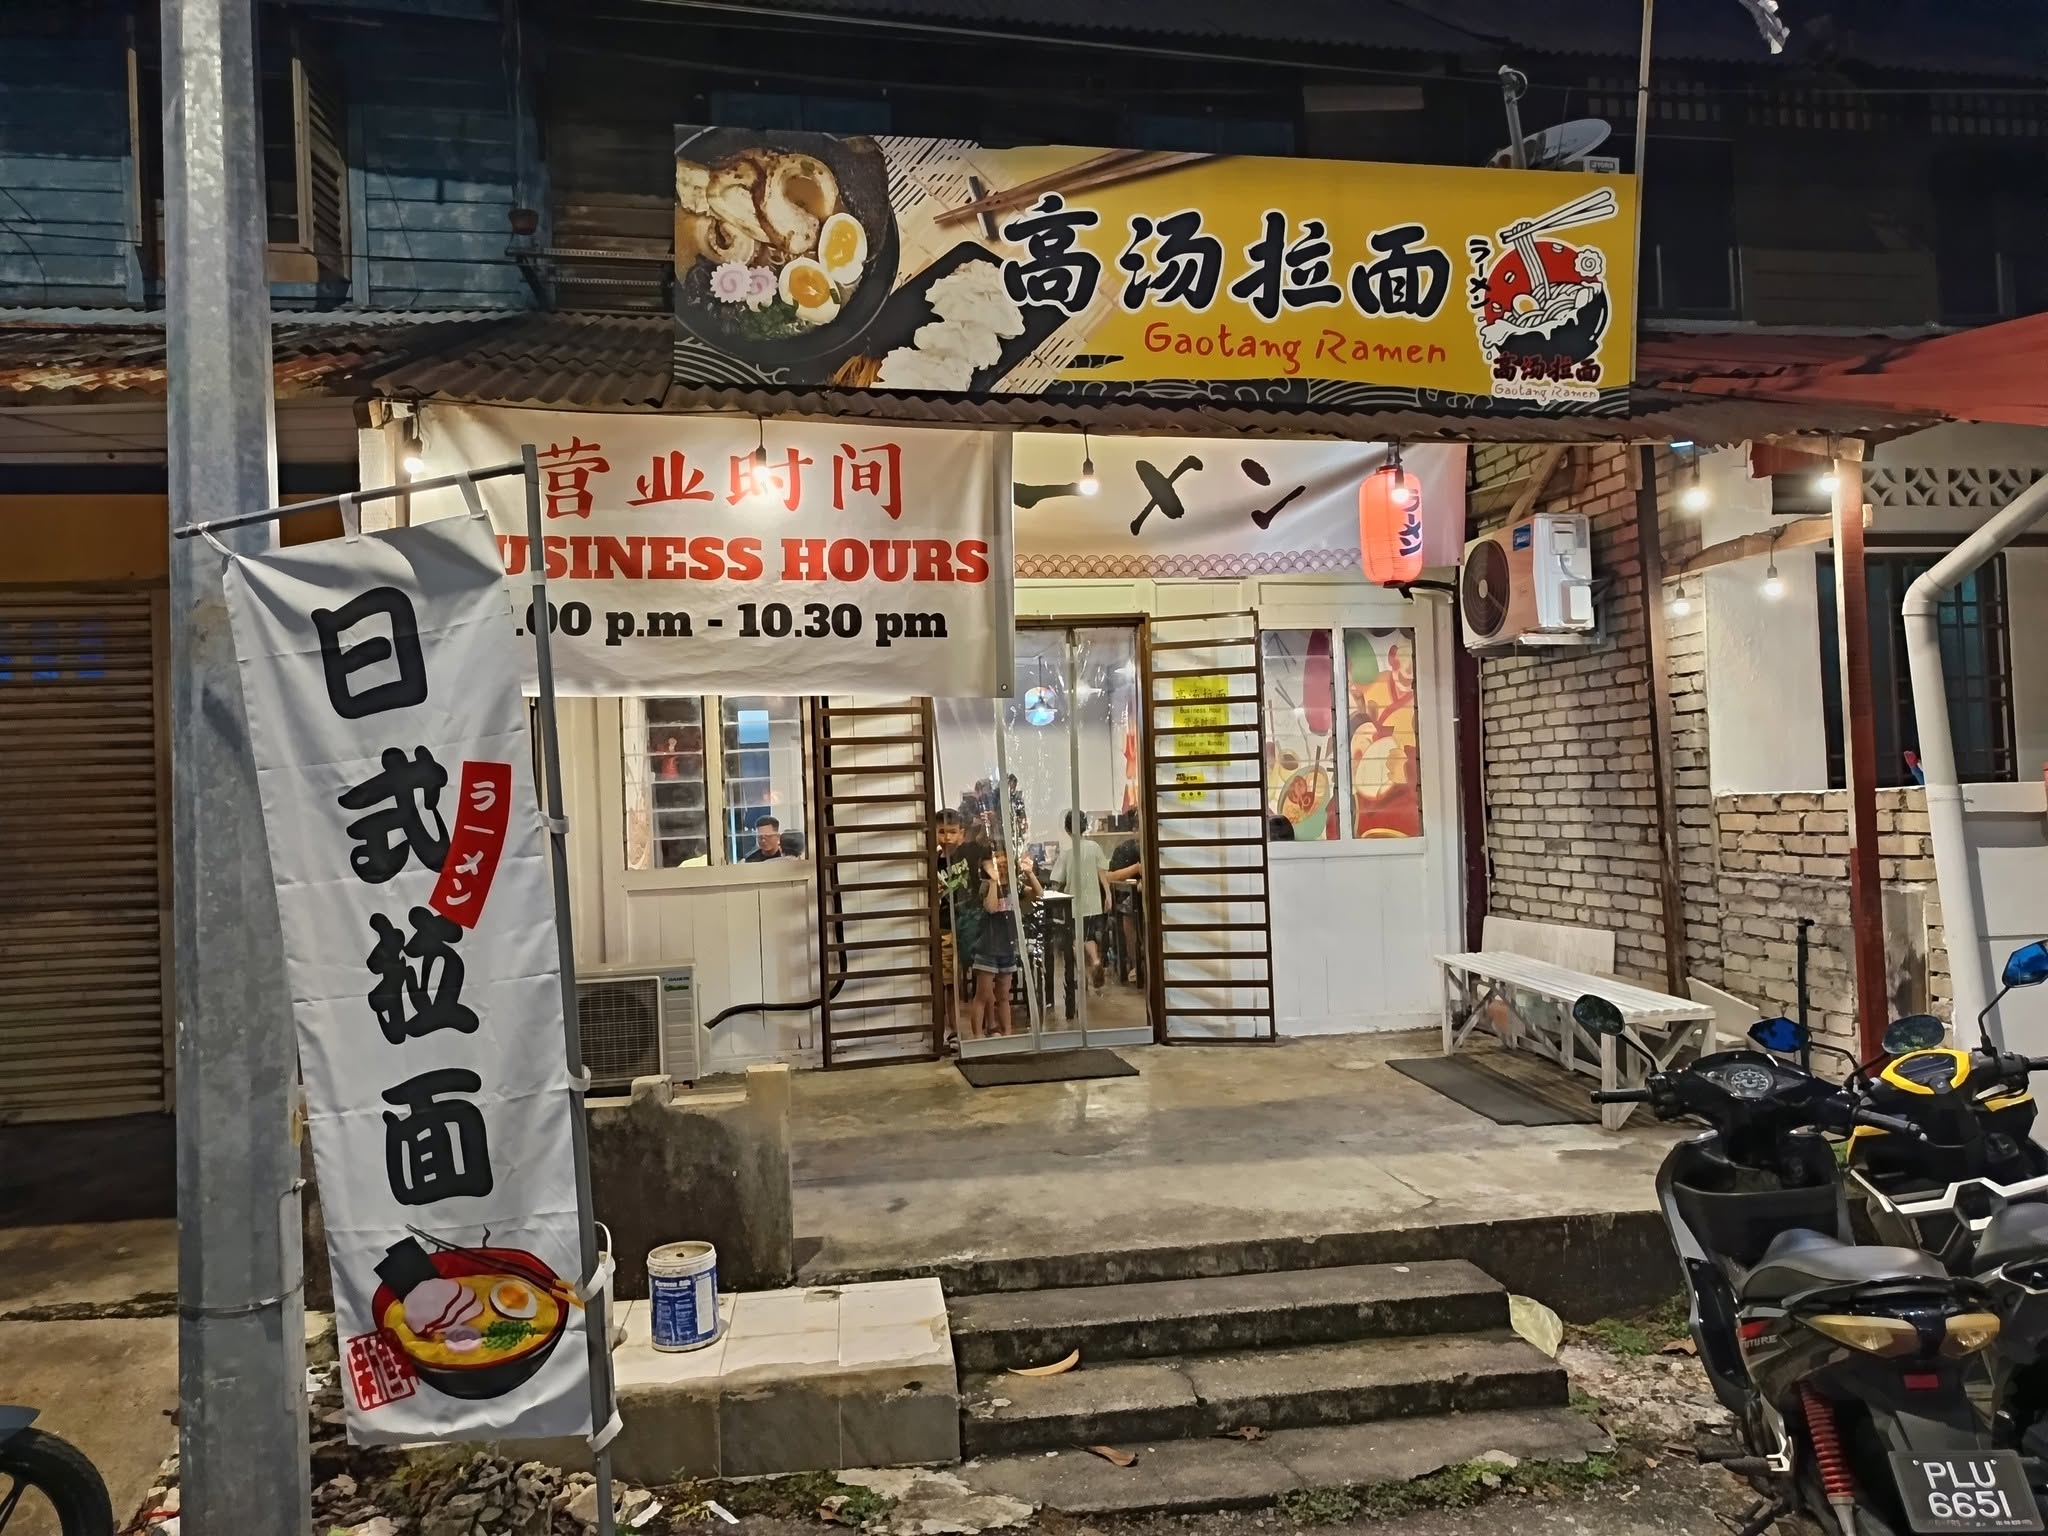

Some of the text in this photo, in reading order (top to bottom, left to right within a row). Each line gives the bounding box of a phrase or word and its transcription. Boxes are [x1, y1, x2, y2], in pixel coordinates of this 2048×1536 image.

[1003, 194, 1450, 321] 高汤拉面
[1469, 239, 1491, 309] ラーメン
[1144, 322, 1447, 375] Gaotang Ramen
[1493, 353, 1601, 382] 高汤拉面
[1494, 384, 1597, 399] Gaotang Ramen
[538, 436, 902, 521] 营业时间
[496, 535, 990, 584] USINESS HOURS
[605, 611, 693, 646] p.m
[738, 602, 862, 639] 10.30
[875, 612, 948, 648] pm
[447, 781, 496, 905] ラーメン
[311, 586, 494, 1206] 日式拉面
[1922, 1460, 1996, 1490] PLU
[1928, 1490, 2013, 1519] 6651
